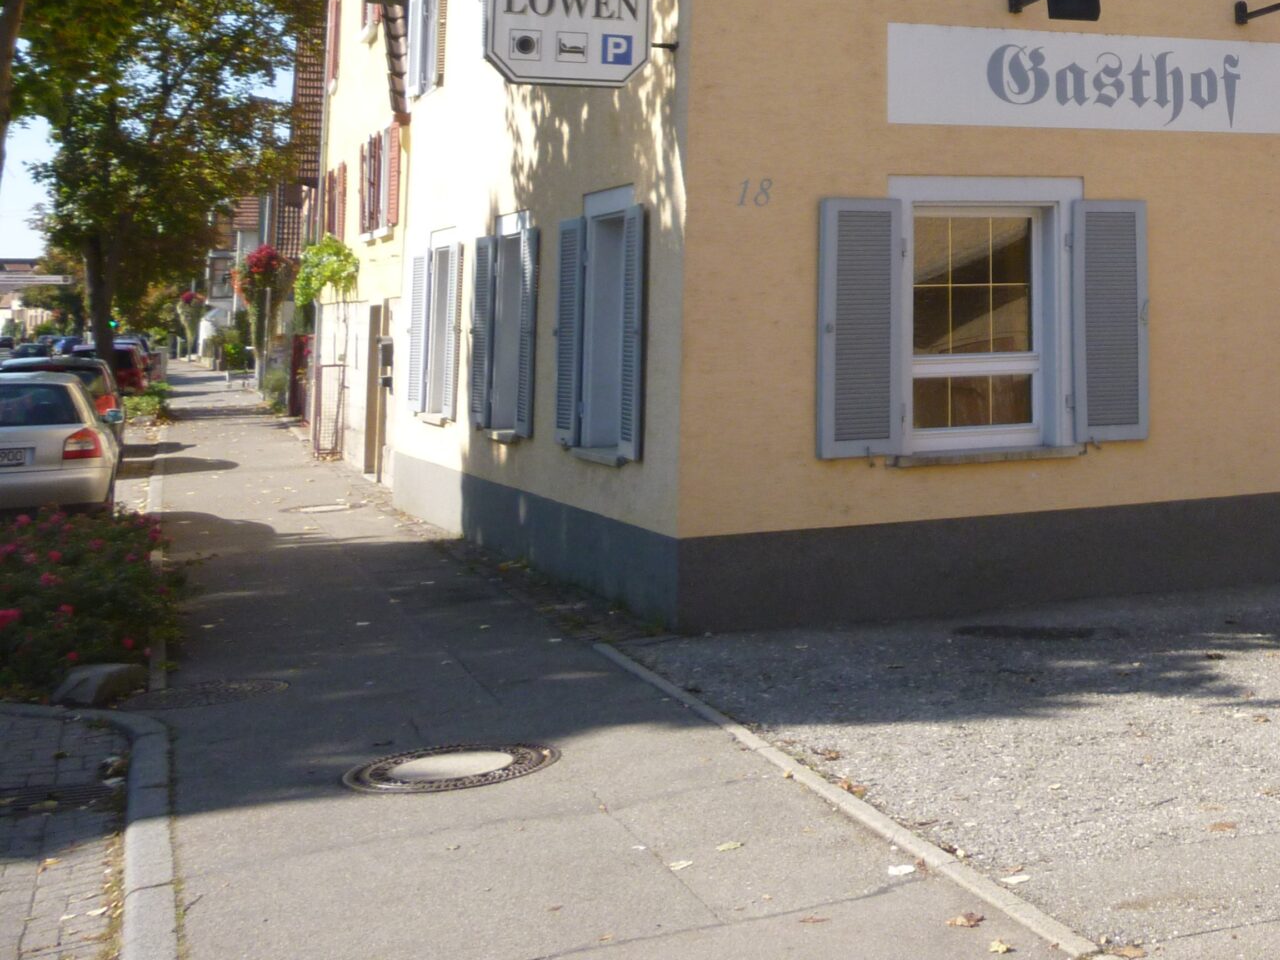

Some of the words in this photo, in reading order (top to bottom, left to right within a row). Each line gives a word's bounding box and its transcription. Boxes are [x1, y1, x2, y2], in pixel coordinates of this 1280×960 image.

[607, 38, 627, 62] P
[986, 43, 1241, 128] Gasthof
[736, 177, 773, 208] 18
